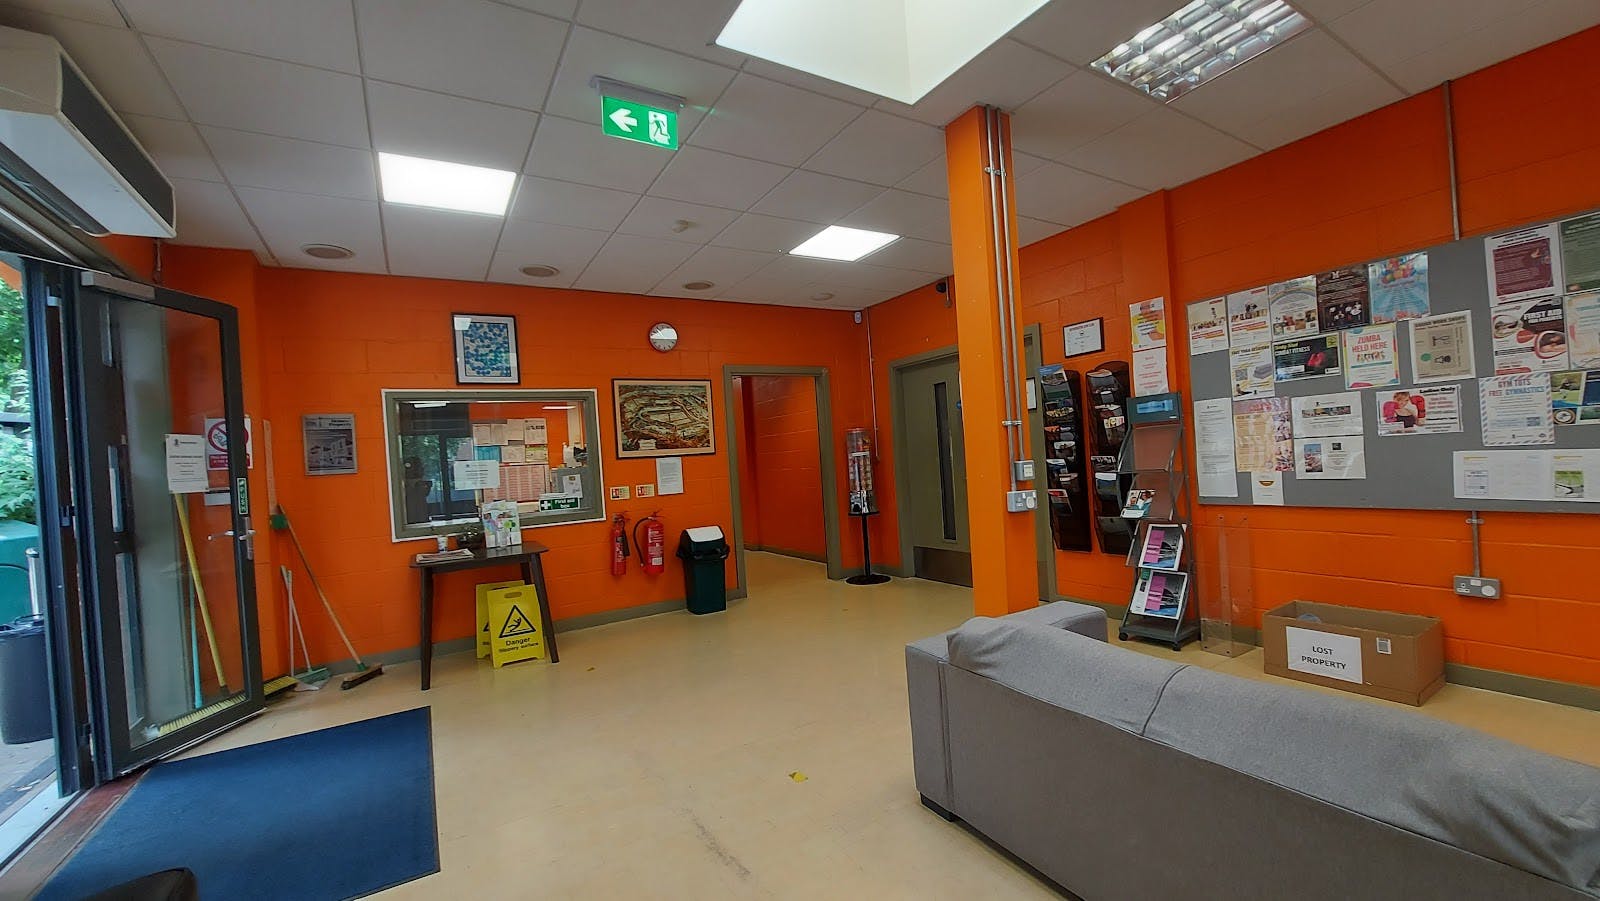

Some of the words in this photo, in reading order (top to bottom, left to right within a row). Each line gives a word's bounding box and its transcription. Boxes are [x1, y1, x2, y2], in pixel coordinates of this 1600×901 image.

[1523, 311, 1546, 321] FIRST
[1547, 308, 1561, 317] AID
[1358, 334, 1381, 344] ZUMBA
[1291, 345, 1312, 353] FITNESS
[1352, 344, 1369, 353] HELD
[1370, 341, 1388, 350] HERE
[1498, 380, 1513, 388] GYM
[1514, 378, 1532, 387] TOTS
[1488, 389, 1502, 397] FREE
[1505, 385, 1545, 396] GYMNASTICS
[505, 638, 530, 646] Danger
[1312, 646, 1333, 655] LOST
[1302, 656, 1346, 669] PROPERTY
